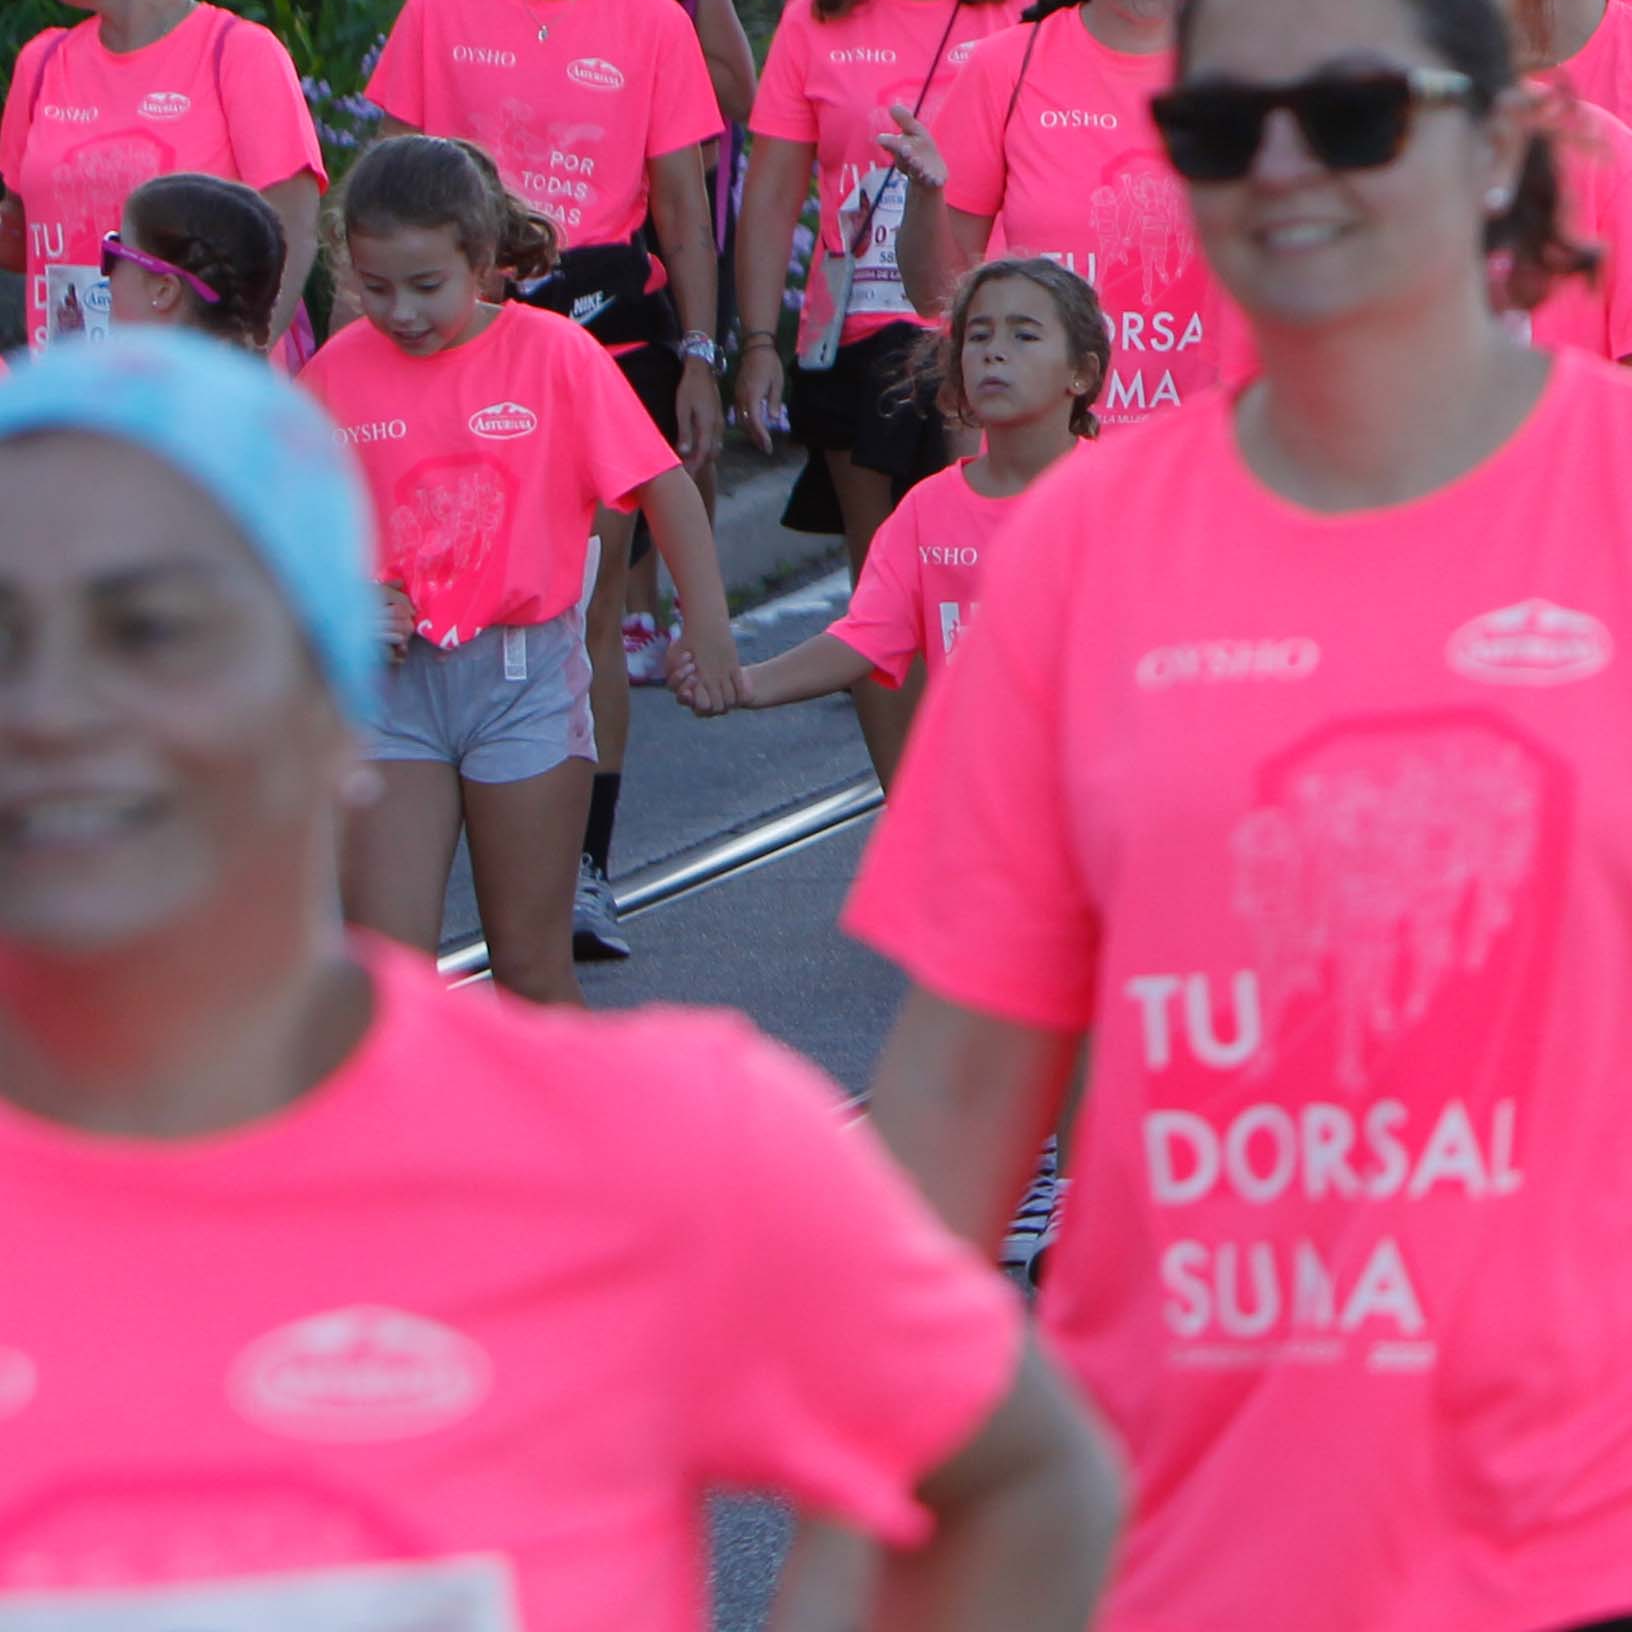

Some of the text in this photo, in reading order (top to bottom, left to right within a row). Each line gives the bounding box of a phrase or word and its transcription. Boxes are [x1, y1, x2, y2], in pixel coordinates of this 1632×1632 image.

[453, 45, 516, 67] OYSHO
[830, 48, 896, 63] OYSHO
[1040, 110, 1118, 129] OYSHO
[550, 151, 594, 176] POR
[522, 171, 588, 200] TODAS
[30, 224, 64, 257] TU
[573, 290, 603, 315] NIKE
[331, 419, 407, 449] OYSHO
[1125, 970, 1262, 1069] TU
[1144, 1097, 1524, 1205] DORSAL
